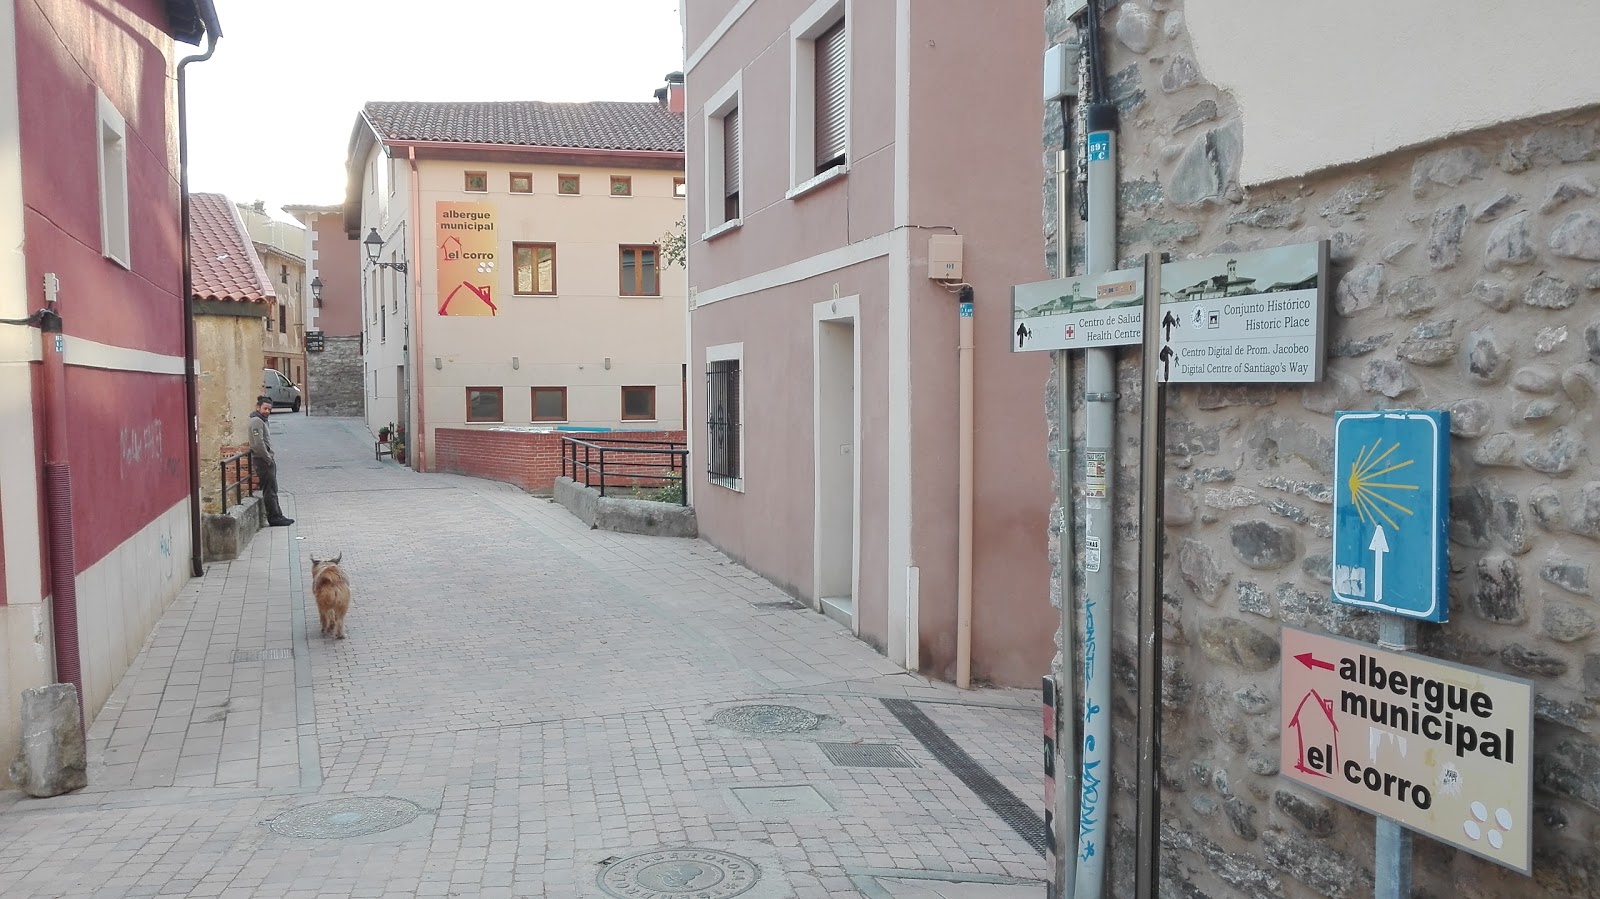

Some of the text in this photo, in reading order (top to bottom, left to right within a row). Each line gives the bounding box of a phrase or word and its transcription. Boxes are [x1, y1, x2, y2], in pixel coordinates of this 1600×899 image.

[442, 210, 491, 220] albergue
[440, 222, 494, 231] municipal
[448, 250, 494, 260] el corro
[1224, 298, 1311, 317] Conjunto Histórico
[1079, 312, 1141, 328] Centro de Salud
[1246, 316, 1310, 331] Historic Place
[1087, 329, 1141, 341] Health Centre
[1181, 343, 1309, 359] Centro Digital de Prom. Jacobeo
[1181, 361, 1309, 376] Digital Centre of Santiago's Way
[1339, 654, 1493, 718] albergue
[1341, 690, 1514, 764] municipal
[1307, 744, 1432, 810] el corro
